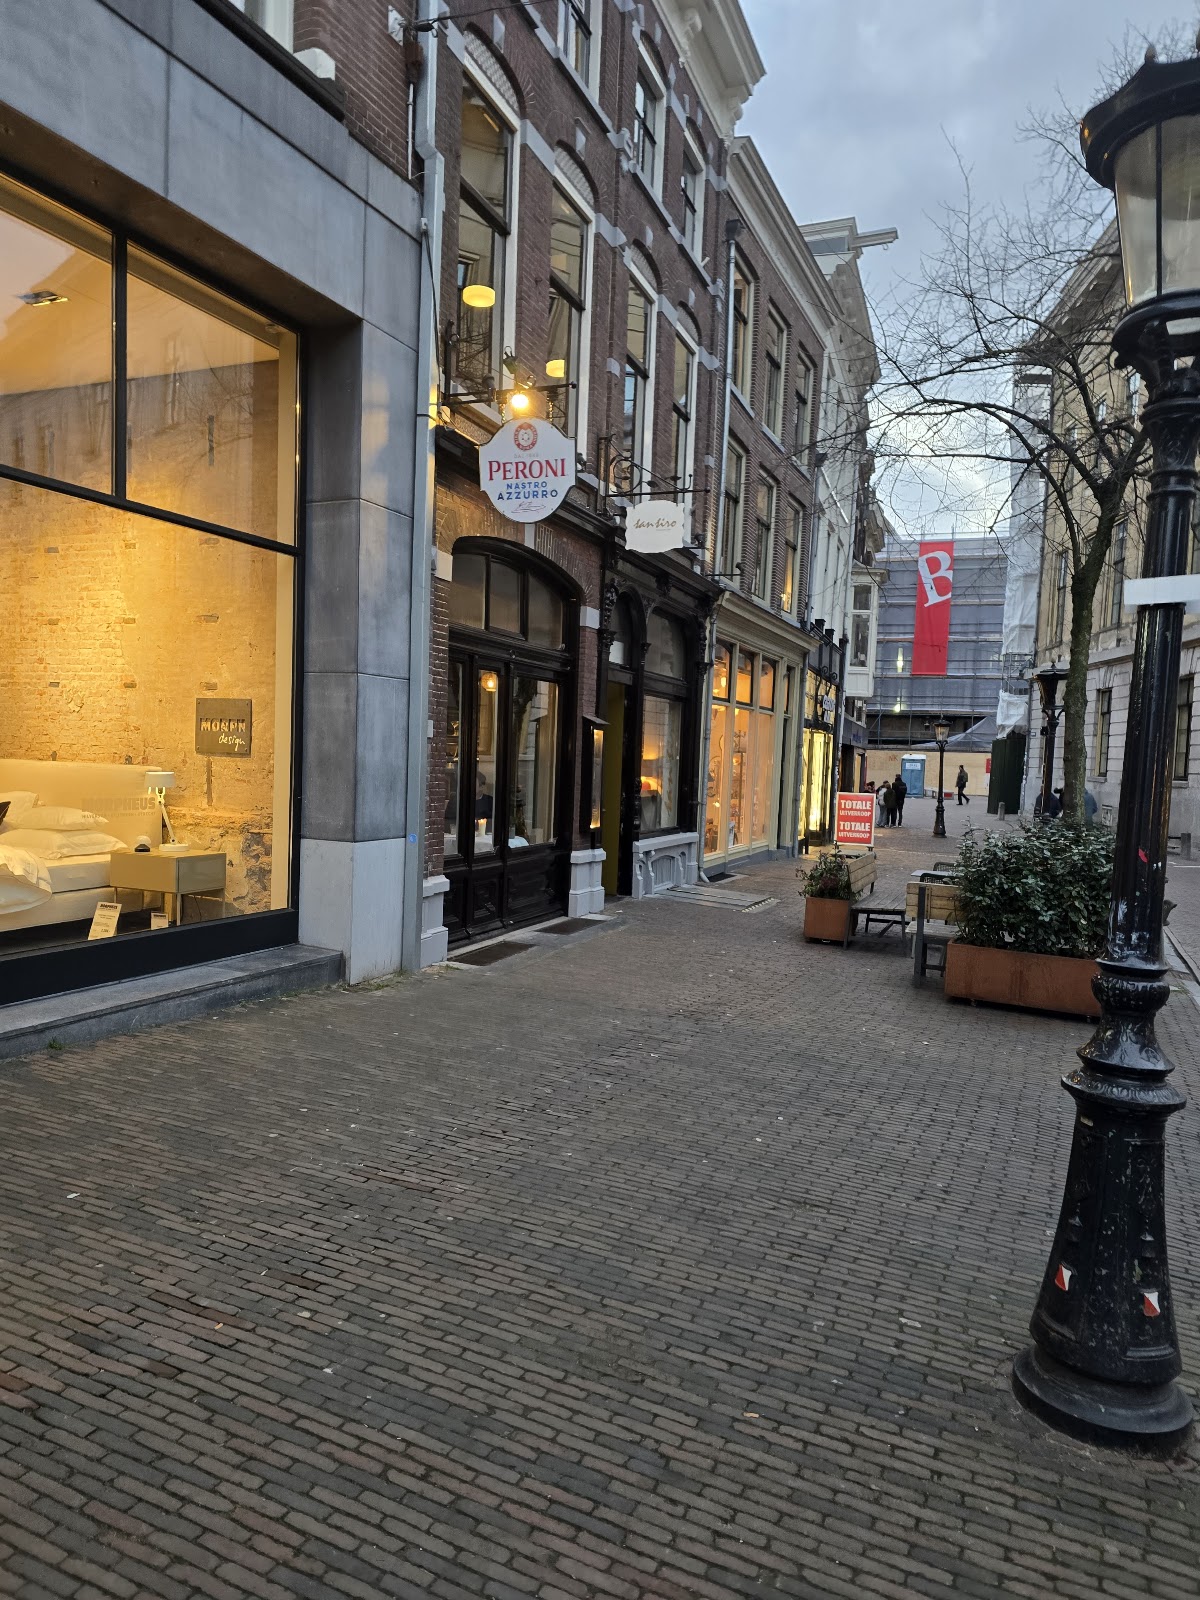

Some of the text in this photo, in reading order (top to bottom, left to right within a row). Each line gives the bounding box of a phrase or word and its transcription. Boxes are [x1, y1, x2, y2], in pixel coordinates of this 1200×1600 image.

[488, 458, 567, 481] PERONI
[506, 481, 548, 490] NASTRO
[497, 489, 559, 501] AZZURRO
[918, 550, 953, 608] B
[219, 733, 246, 751] design
[840, 800, 872, 810] TOTALE
[839, 822, 871, 832] TOTALE
